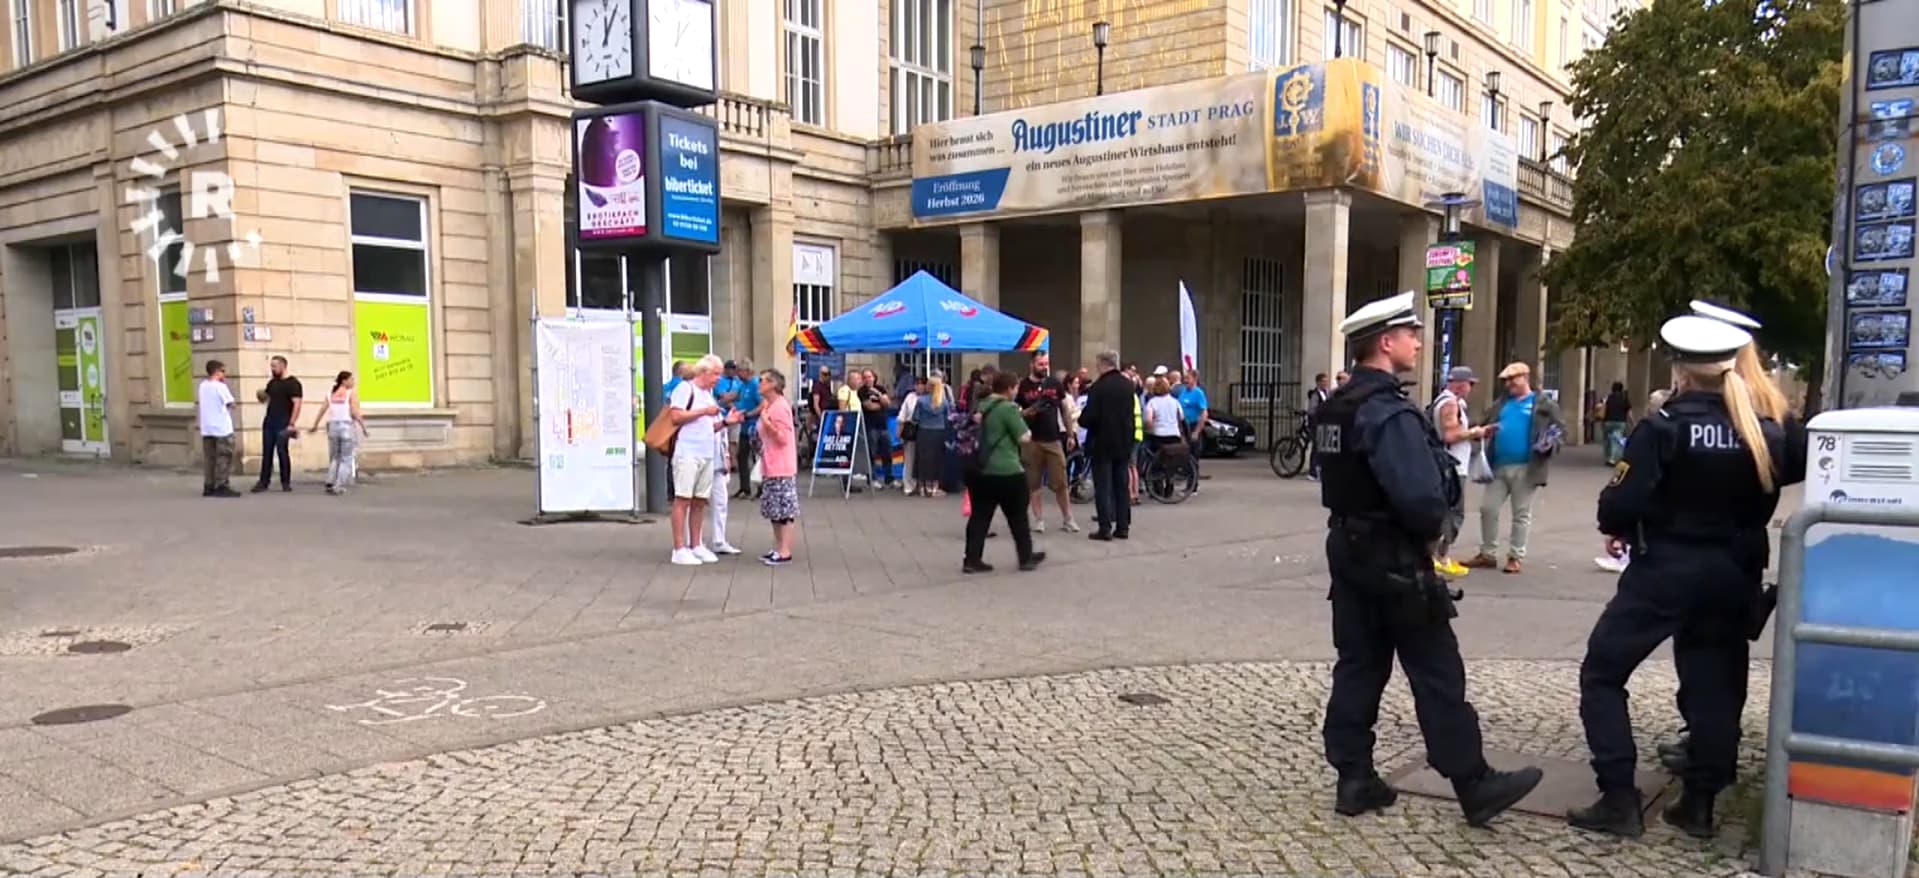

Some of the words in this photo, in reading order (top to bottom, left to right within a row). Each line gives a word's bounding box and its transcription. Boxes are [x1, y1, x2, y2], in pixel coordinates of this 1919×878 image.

[1011, 109, 1142, 154] Augustiner
[1147, 109, 1201, 129] STADT
[1207, 100, 1254, 120] PRAG
[668, 132, 708, 155] Tickets
[929, 137, 948, 149] Hier
[975, 130, 994, 141] sich
[679, 152, 698, 170] bei
[929, 153, 946, 162] was
[947, 146, 995, 161] zusammen
[1025, 160, 1041, 172] ein
[1042, 158, 1071, 170] neues
[1072, 149, 1128, 166] Augustiner
[1129, 143, 1184, 158] Wirtshaus
[1185, 133, 1237, 151] entsteht!
[664, 175, 713, 196] biberticket
[932, 180, 981, 194] Eröffnung
[927, 195, 960, 209] Herbst
[960, 193, 985, 205] 2026
